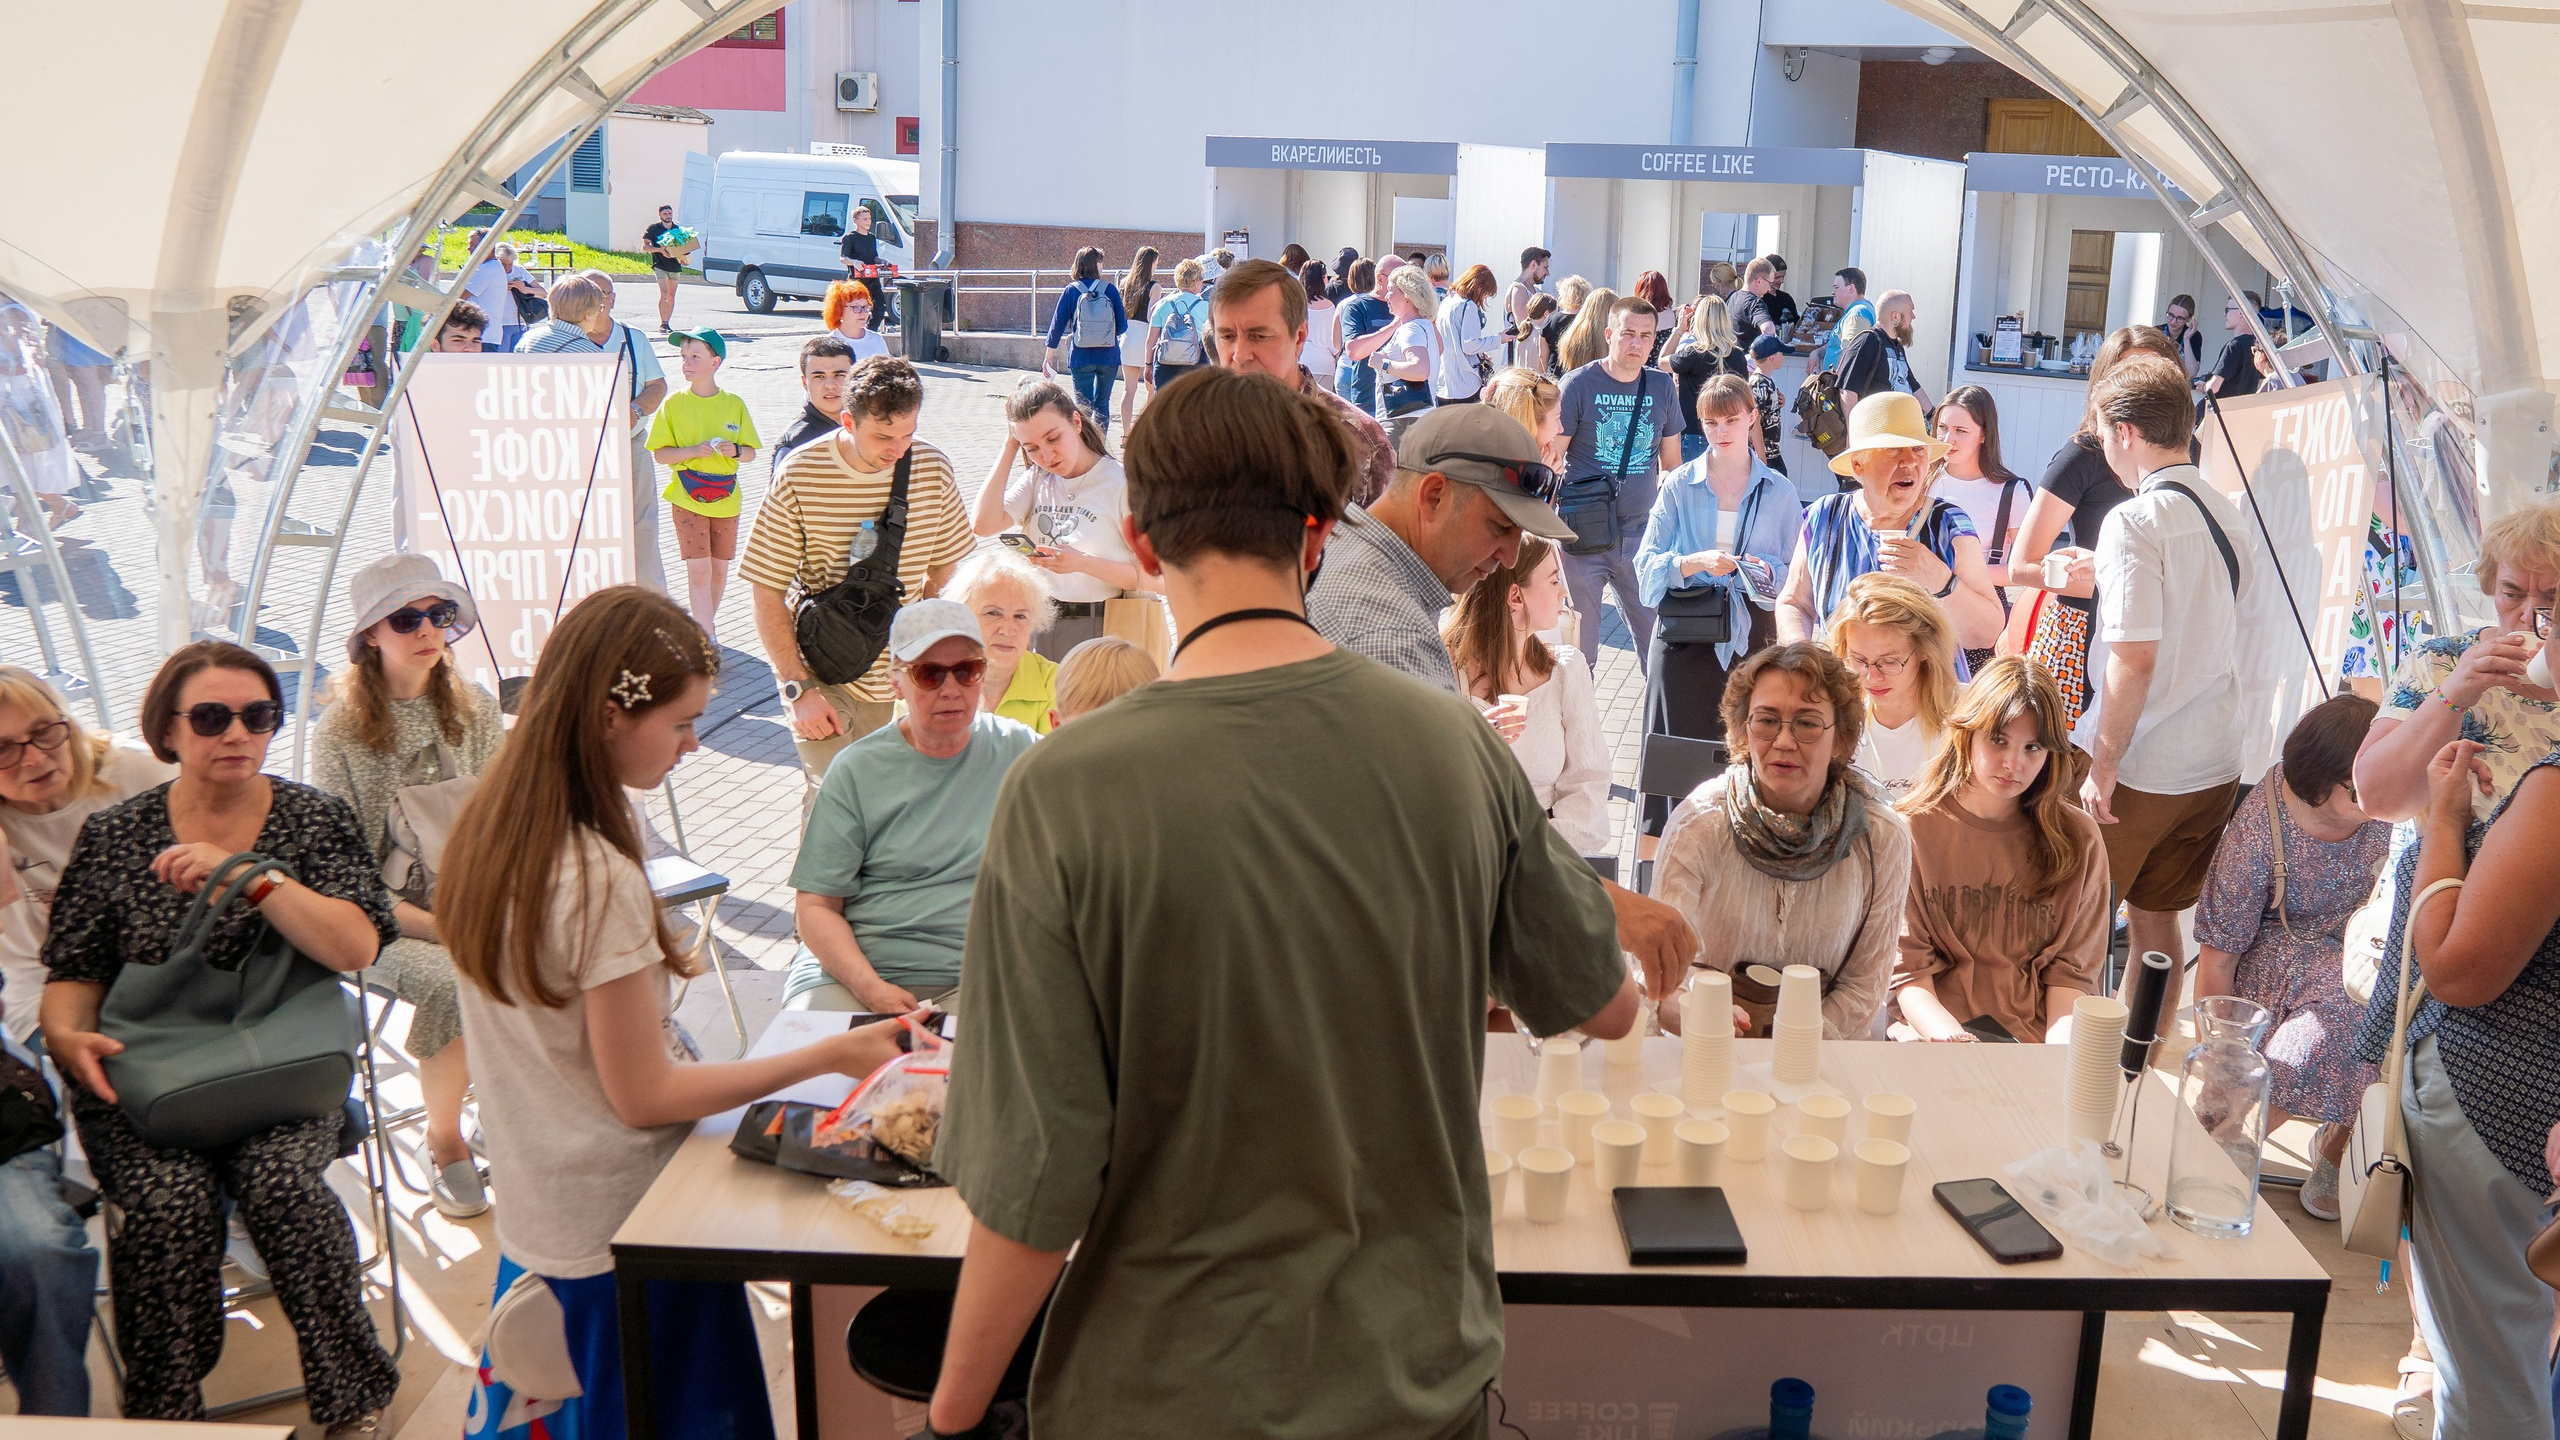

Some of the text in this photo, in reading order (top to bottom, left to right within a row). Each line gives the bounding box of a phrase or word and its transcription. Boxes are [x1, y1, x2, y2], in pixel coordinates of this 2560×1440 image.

[1271, 144, 1382, 165] ВКАРЕЛИИЕСТЬ
[1641, 152, 1755, 175] COFFEE LIKE
[2046, 164, 2184, 192] РЕСТО-КФ
[1594, 393, 1653, 407] ADVAND
